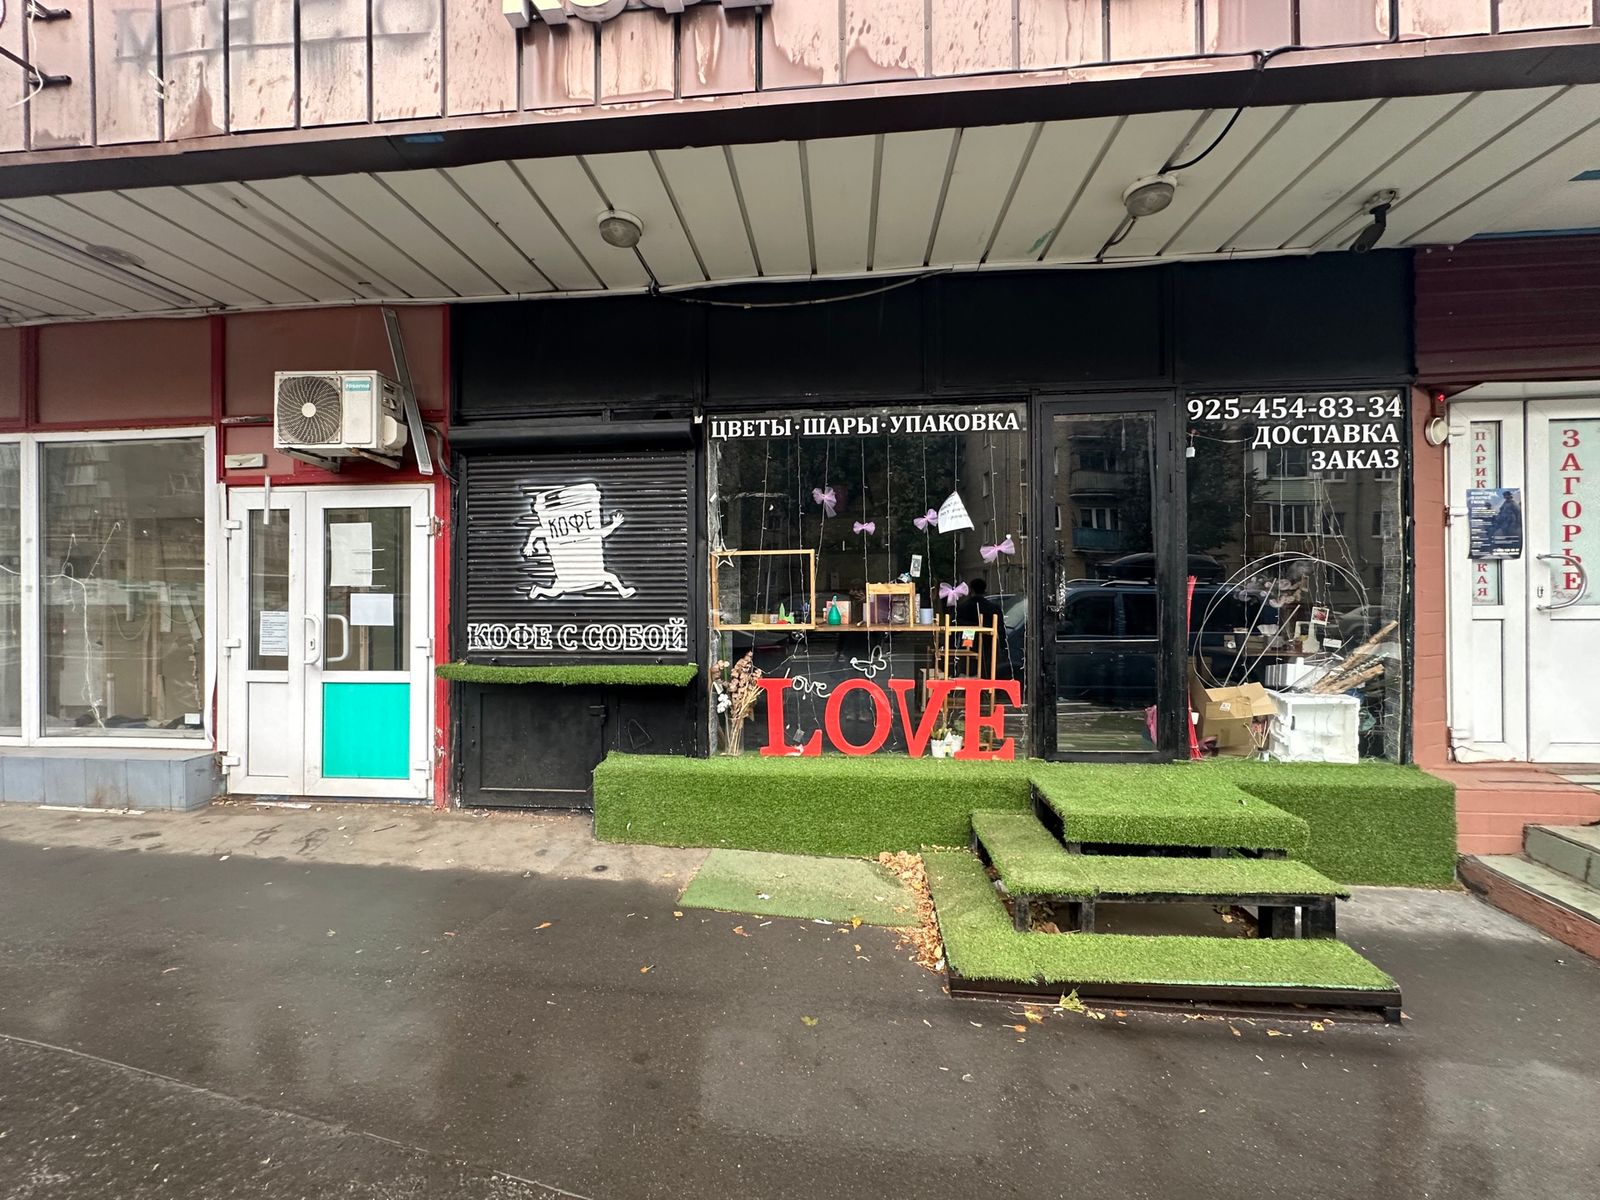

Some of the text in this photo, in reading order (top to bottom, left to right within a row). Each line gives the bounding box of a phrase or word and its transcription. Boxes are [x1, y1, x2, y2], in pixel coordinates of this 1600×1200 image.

[1187, 396, 1404, 420] 925-454-83-34
[890, 413, 1019, 433] УПАКОВКА
[1252, 424, 1399, 449] ДОСТАВКА
[1311, 449, 1399, 470] ЗАКАЗ
[548, 510, 595, 538] КОФЕ
[467, 617, 688, 651] КОФЕ С СОБОЙ
[757, 678, 1021, 761] LOVE
